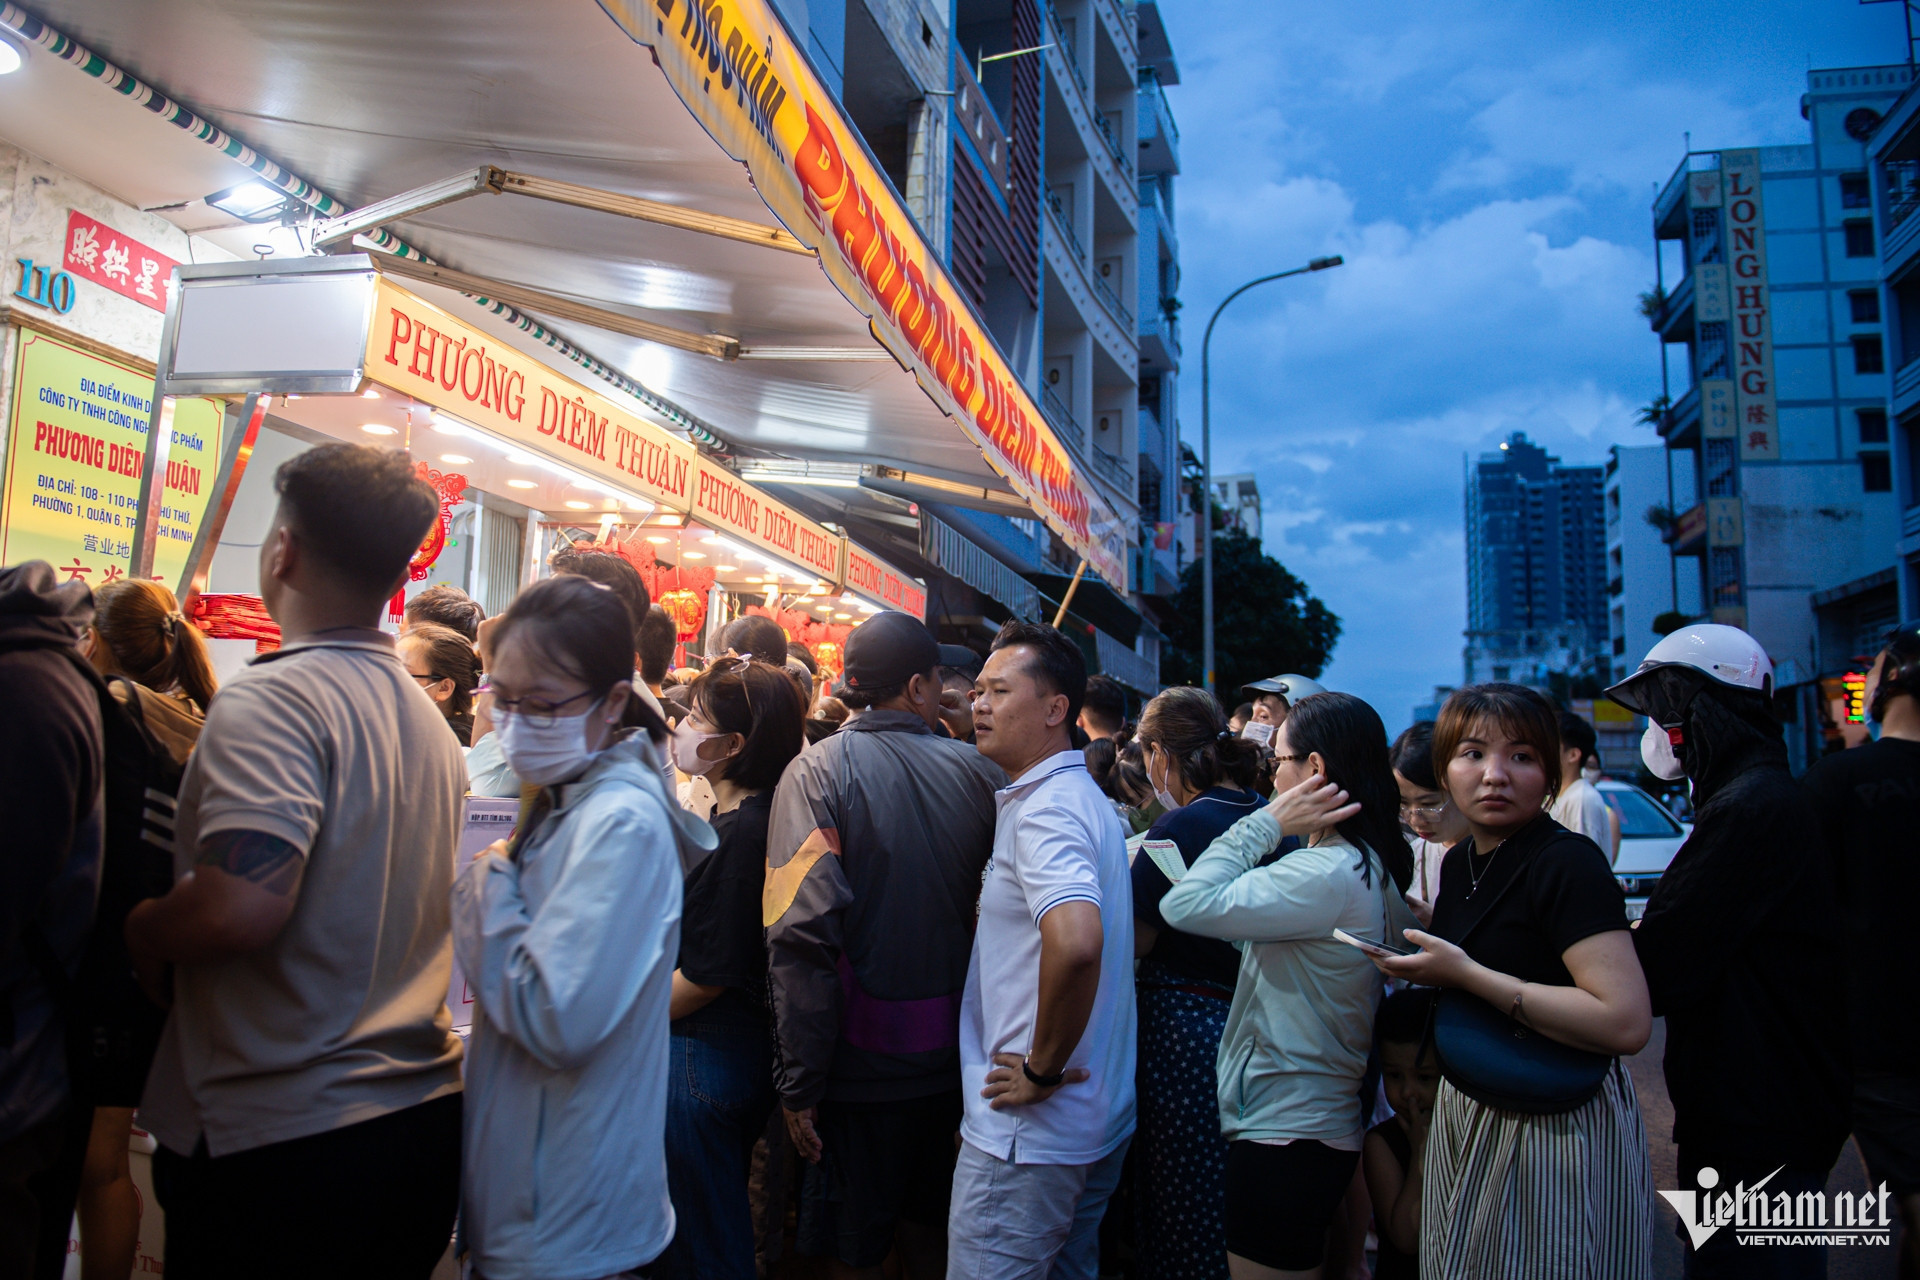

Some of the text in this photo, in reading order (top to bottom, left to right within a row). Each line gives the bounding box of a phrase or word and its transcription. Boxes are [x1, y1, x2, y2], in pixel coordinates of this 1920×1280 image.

[1728, 172, 1760, 279] LONG
[14, 258, 76, 315] 110
[795, 100, 976, 419] PHƯƠNG
[976, 357, 1037, 490] DIÊM
[1735, 285, 1768, 396] HƯNG
[39, 387, 65, 408] CÔNG
[68, 396, 80, 412] TY
[82, 402, 106, 421] TNHH
[108, 409, 131, 429] CÔNG
[133, 418, 150, 435] NGH
[180, 432, 203, 452] PHẨM
[80, 377, 96, 396] ĐỊA
[98, 383, 120, 404] ĐIỂM
[122, 394, 143, 410] KINH
[384, 307, 689, 498] PHƯƠNG DIÊM THUẬN
[34, 420, 104, 469] PHƯƠNG
[165, 459, 201, 498] UẬN
[32, 494, 73, 515] PHƯỜNG
[86, 507, 112, 526] QUẬN
[171, 529, 193, 543] MINH
[38, 474, 55, 492] ĐỊA
[57, 478, 77, 496] CHỈ:
[80, 485, 98, 501] 108
[108, 492, 125, 508] 110
[159, 505, 171, 519] HÚ
[697, 469, 837, 575] PHƯƠNG DIÊM THUẬN
[83, 534, 130, 559] 营业地
[848, 551, 882, 596] PHƯƠNG
